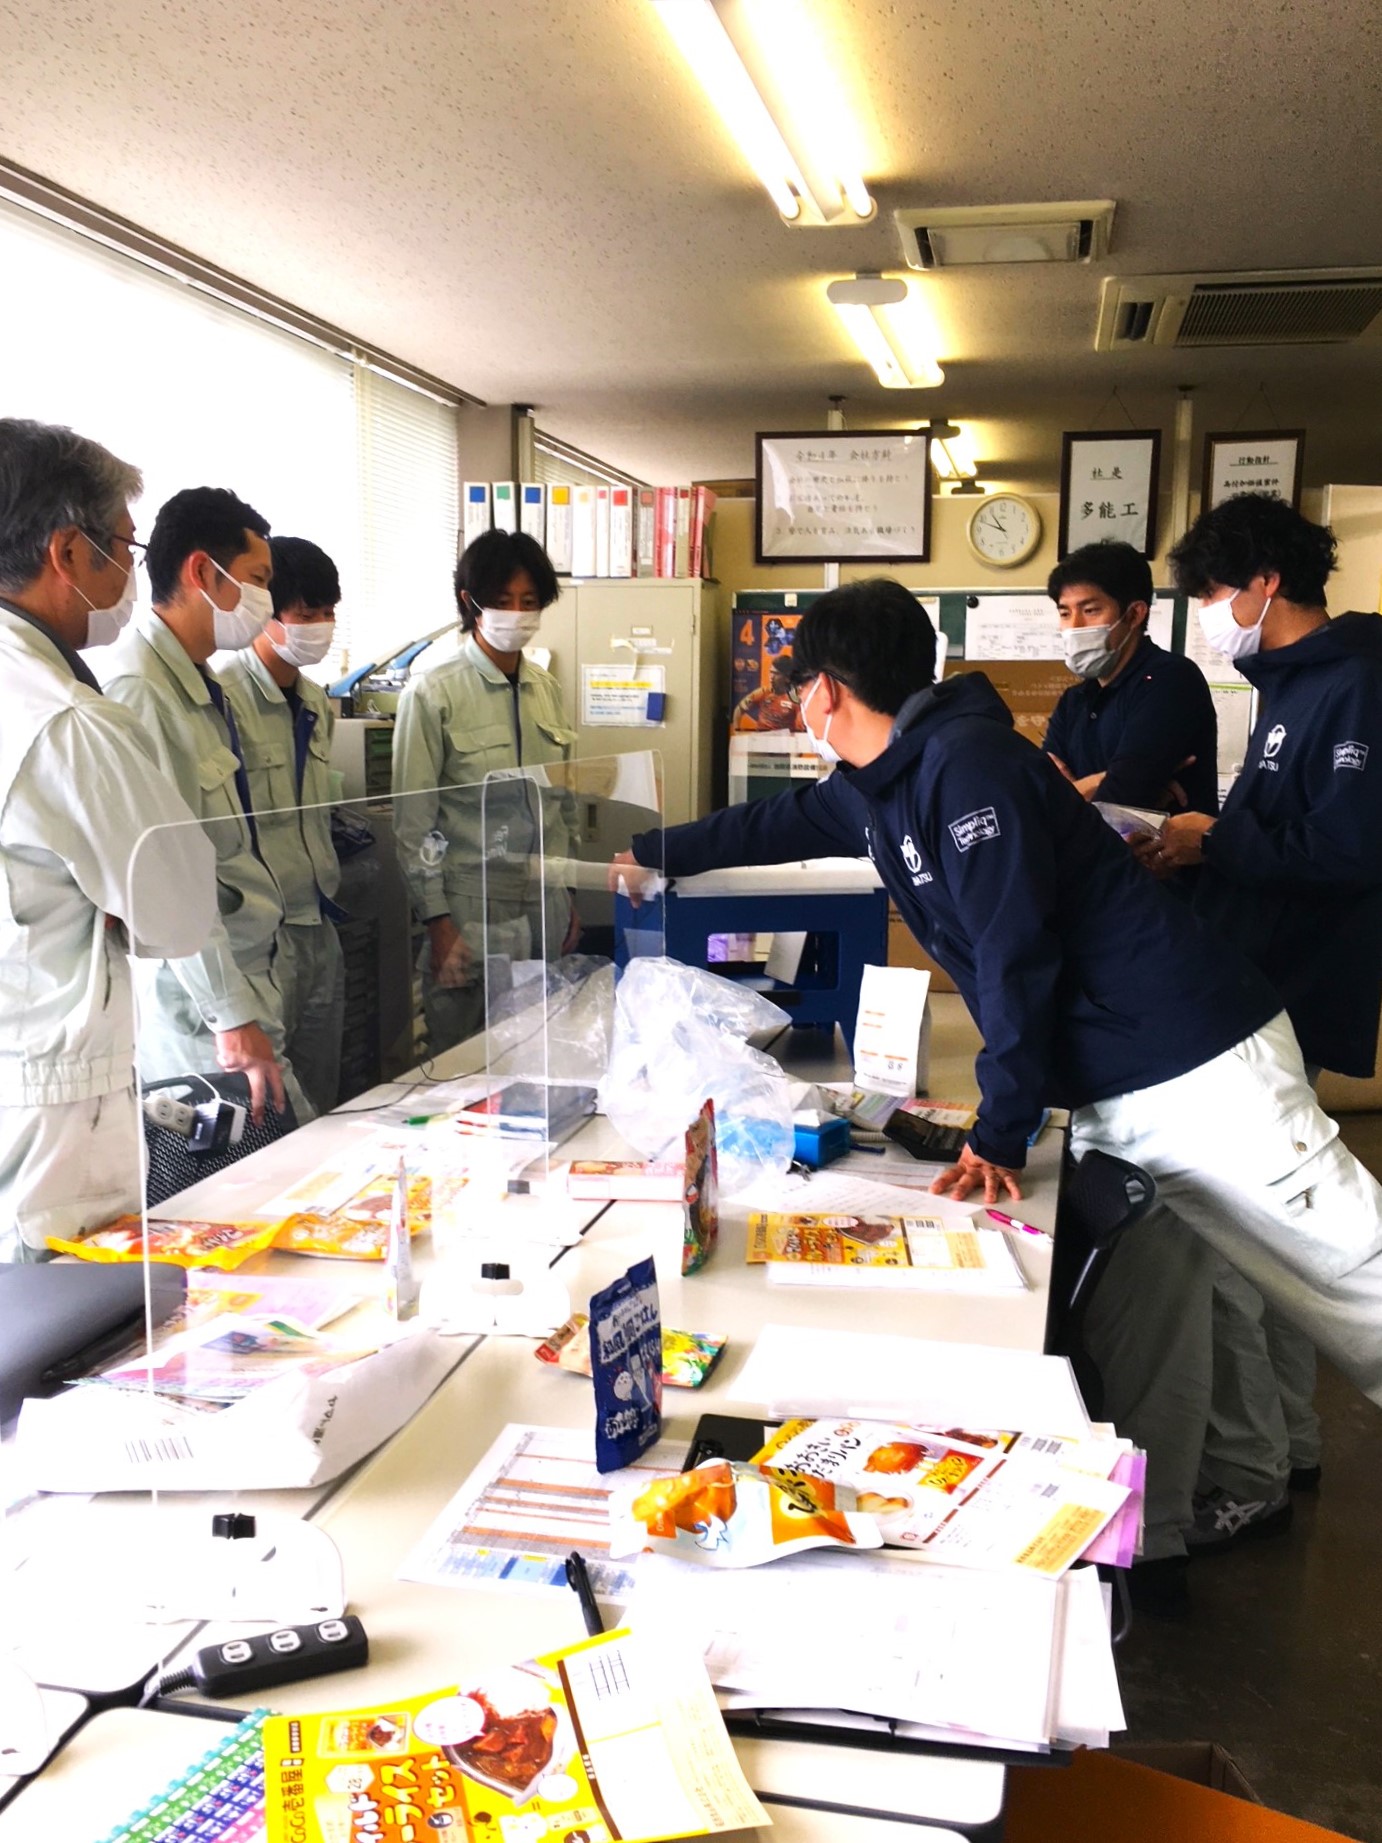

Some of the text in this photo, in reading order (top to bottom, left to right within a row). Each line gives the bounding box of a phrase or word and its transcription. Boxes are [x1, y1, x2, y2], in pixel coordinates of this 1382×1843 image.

[1081, 501, 1139, 520] 多能工
[421, 1755, 456, 1808] セット
